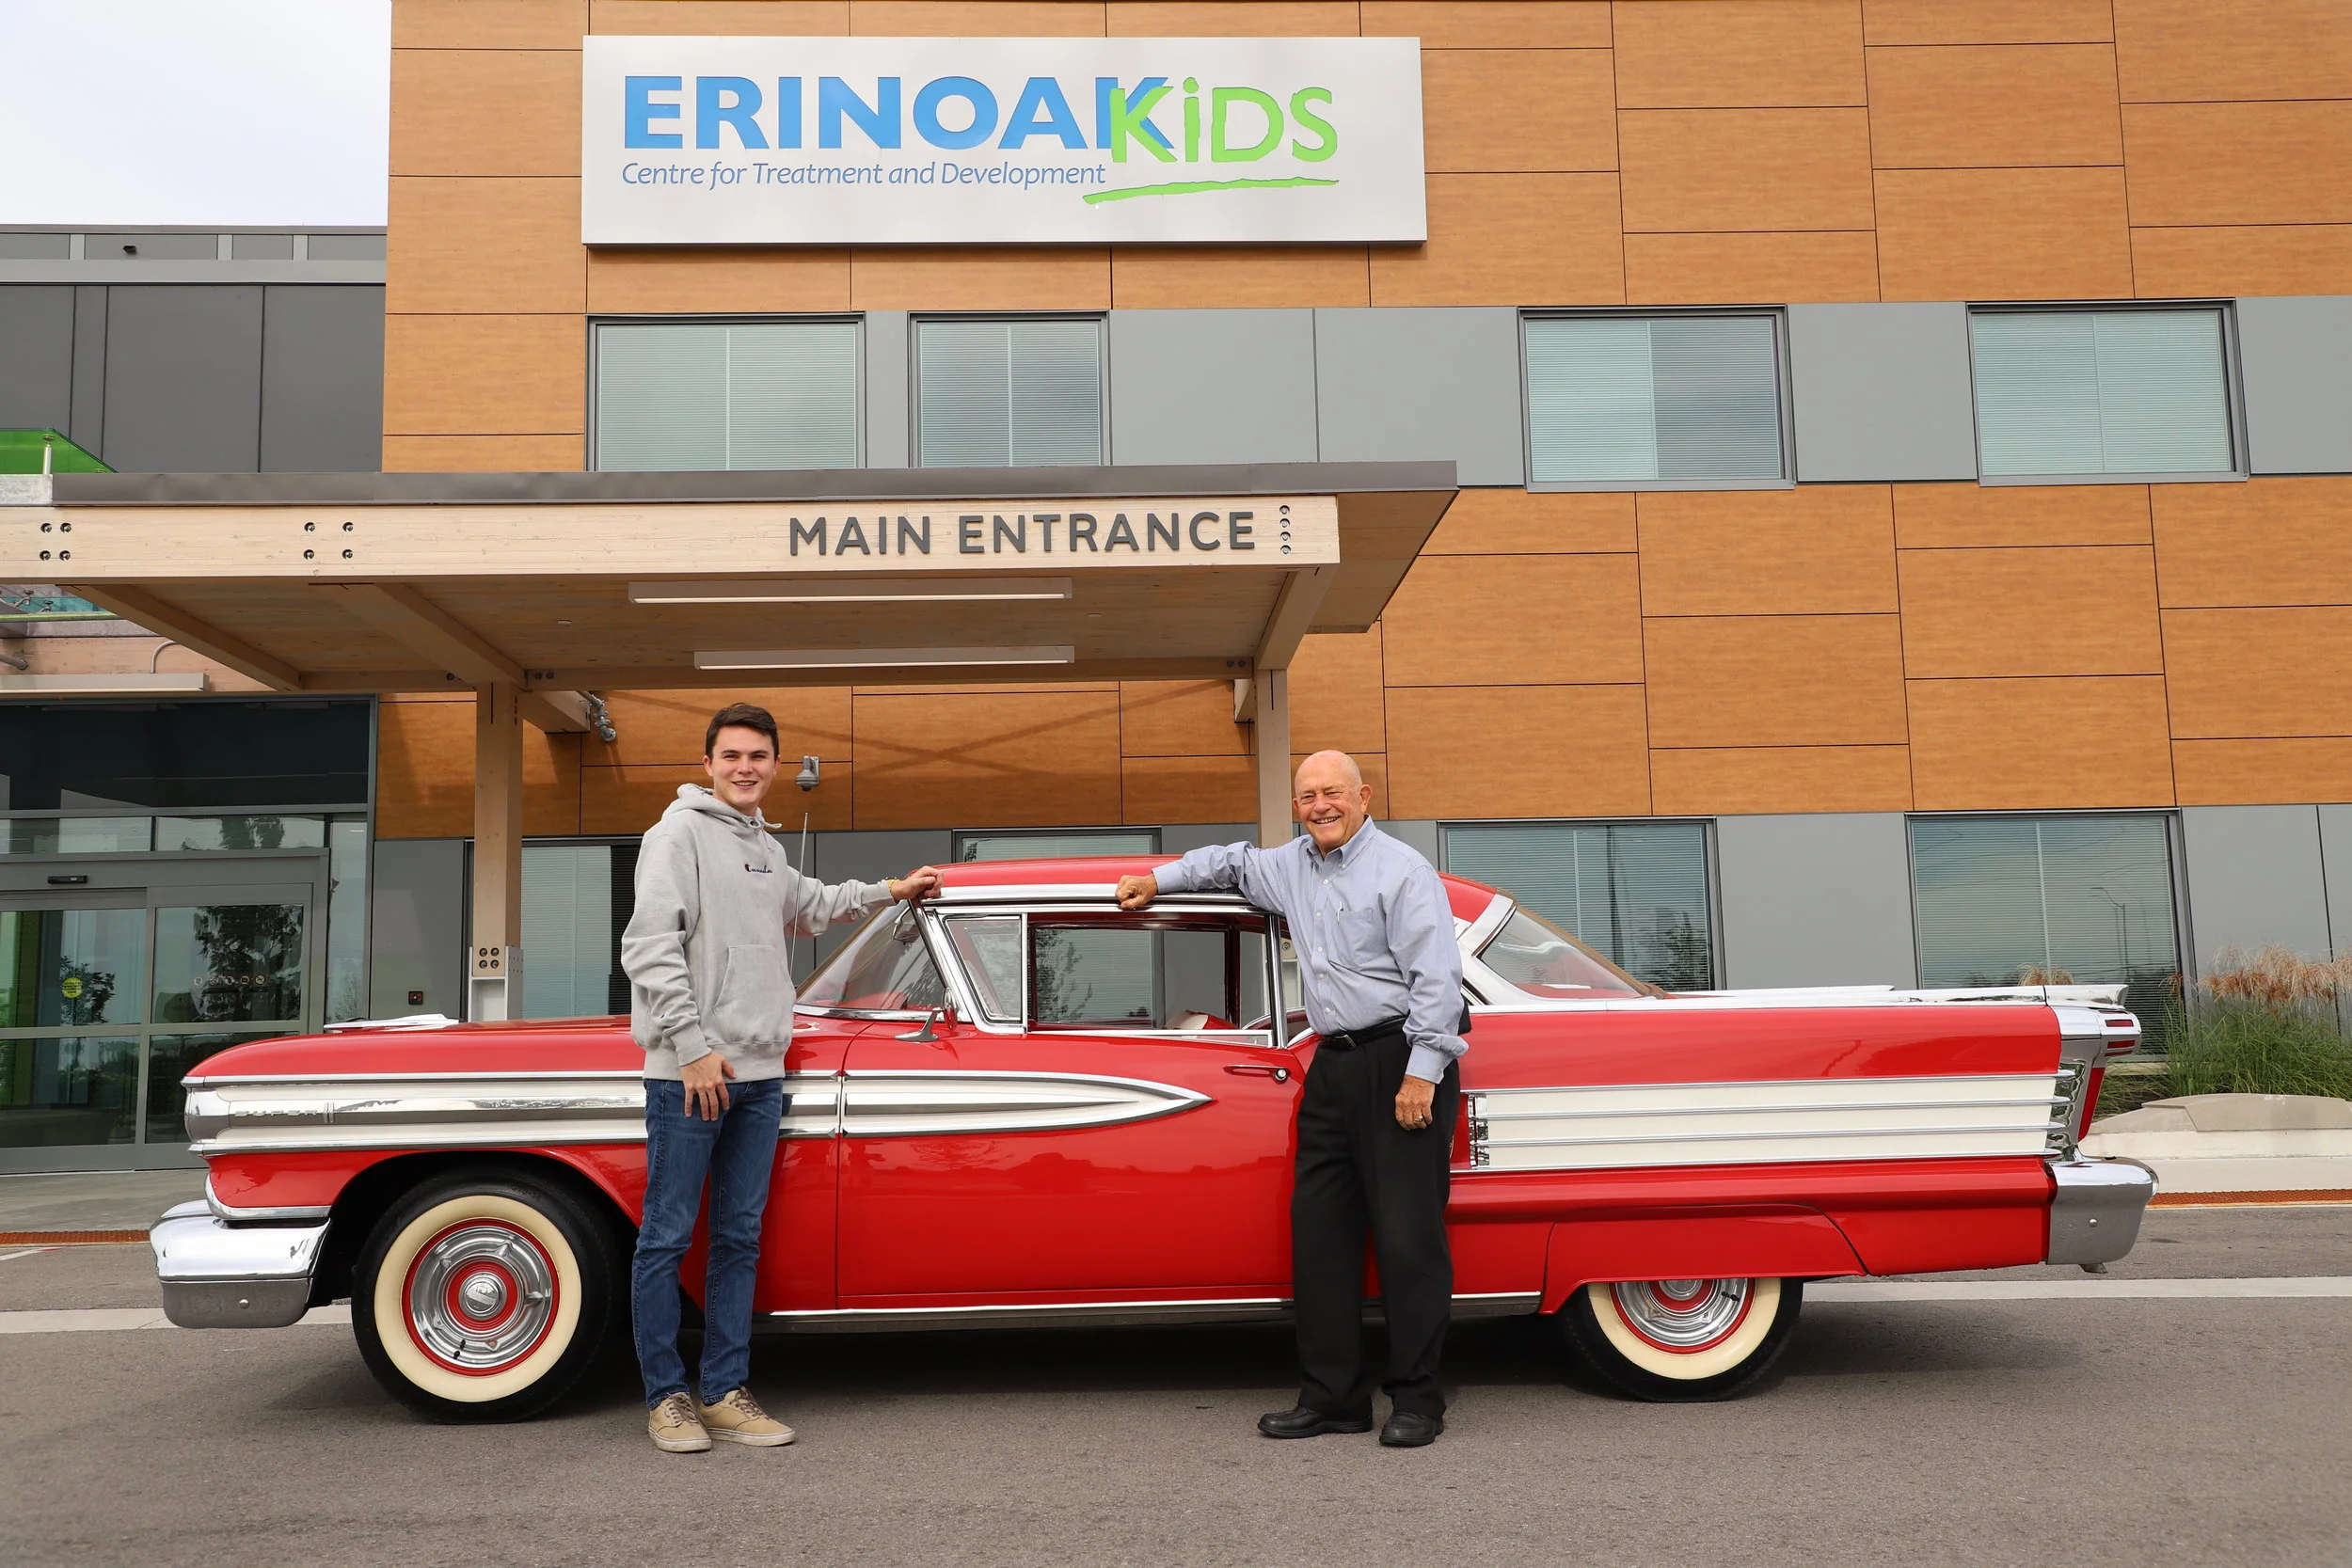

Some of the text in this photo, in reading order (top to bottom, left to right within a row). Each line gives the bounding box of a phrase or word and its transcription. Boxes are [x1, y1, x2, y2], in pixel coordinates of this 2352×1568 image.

[622, 161, 1106, 191] Centre for Treatment and Development
[788, 511, 1256, 557] MAIN ENTRANCE
